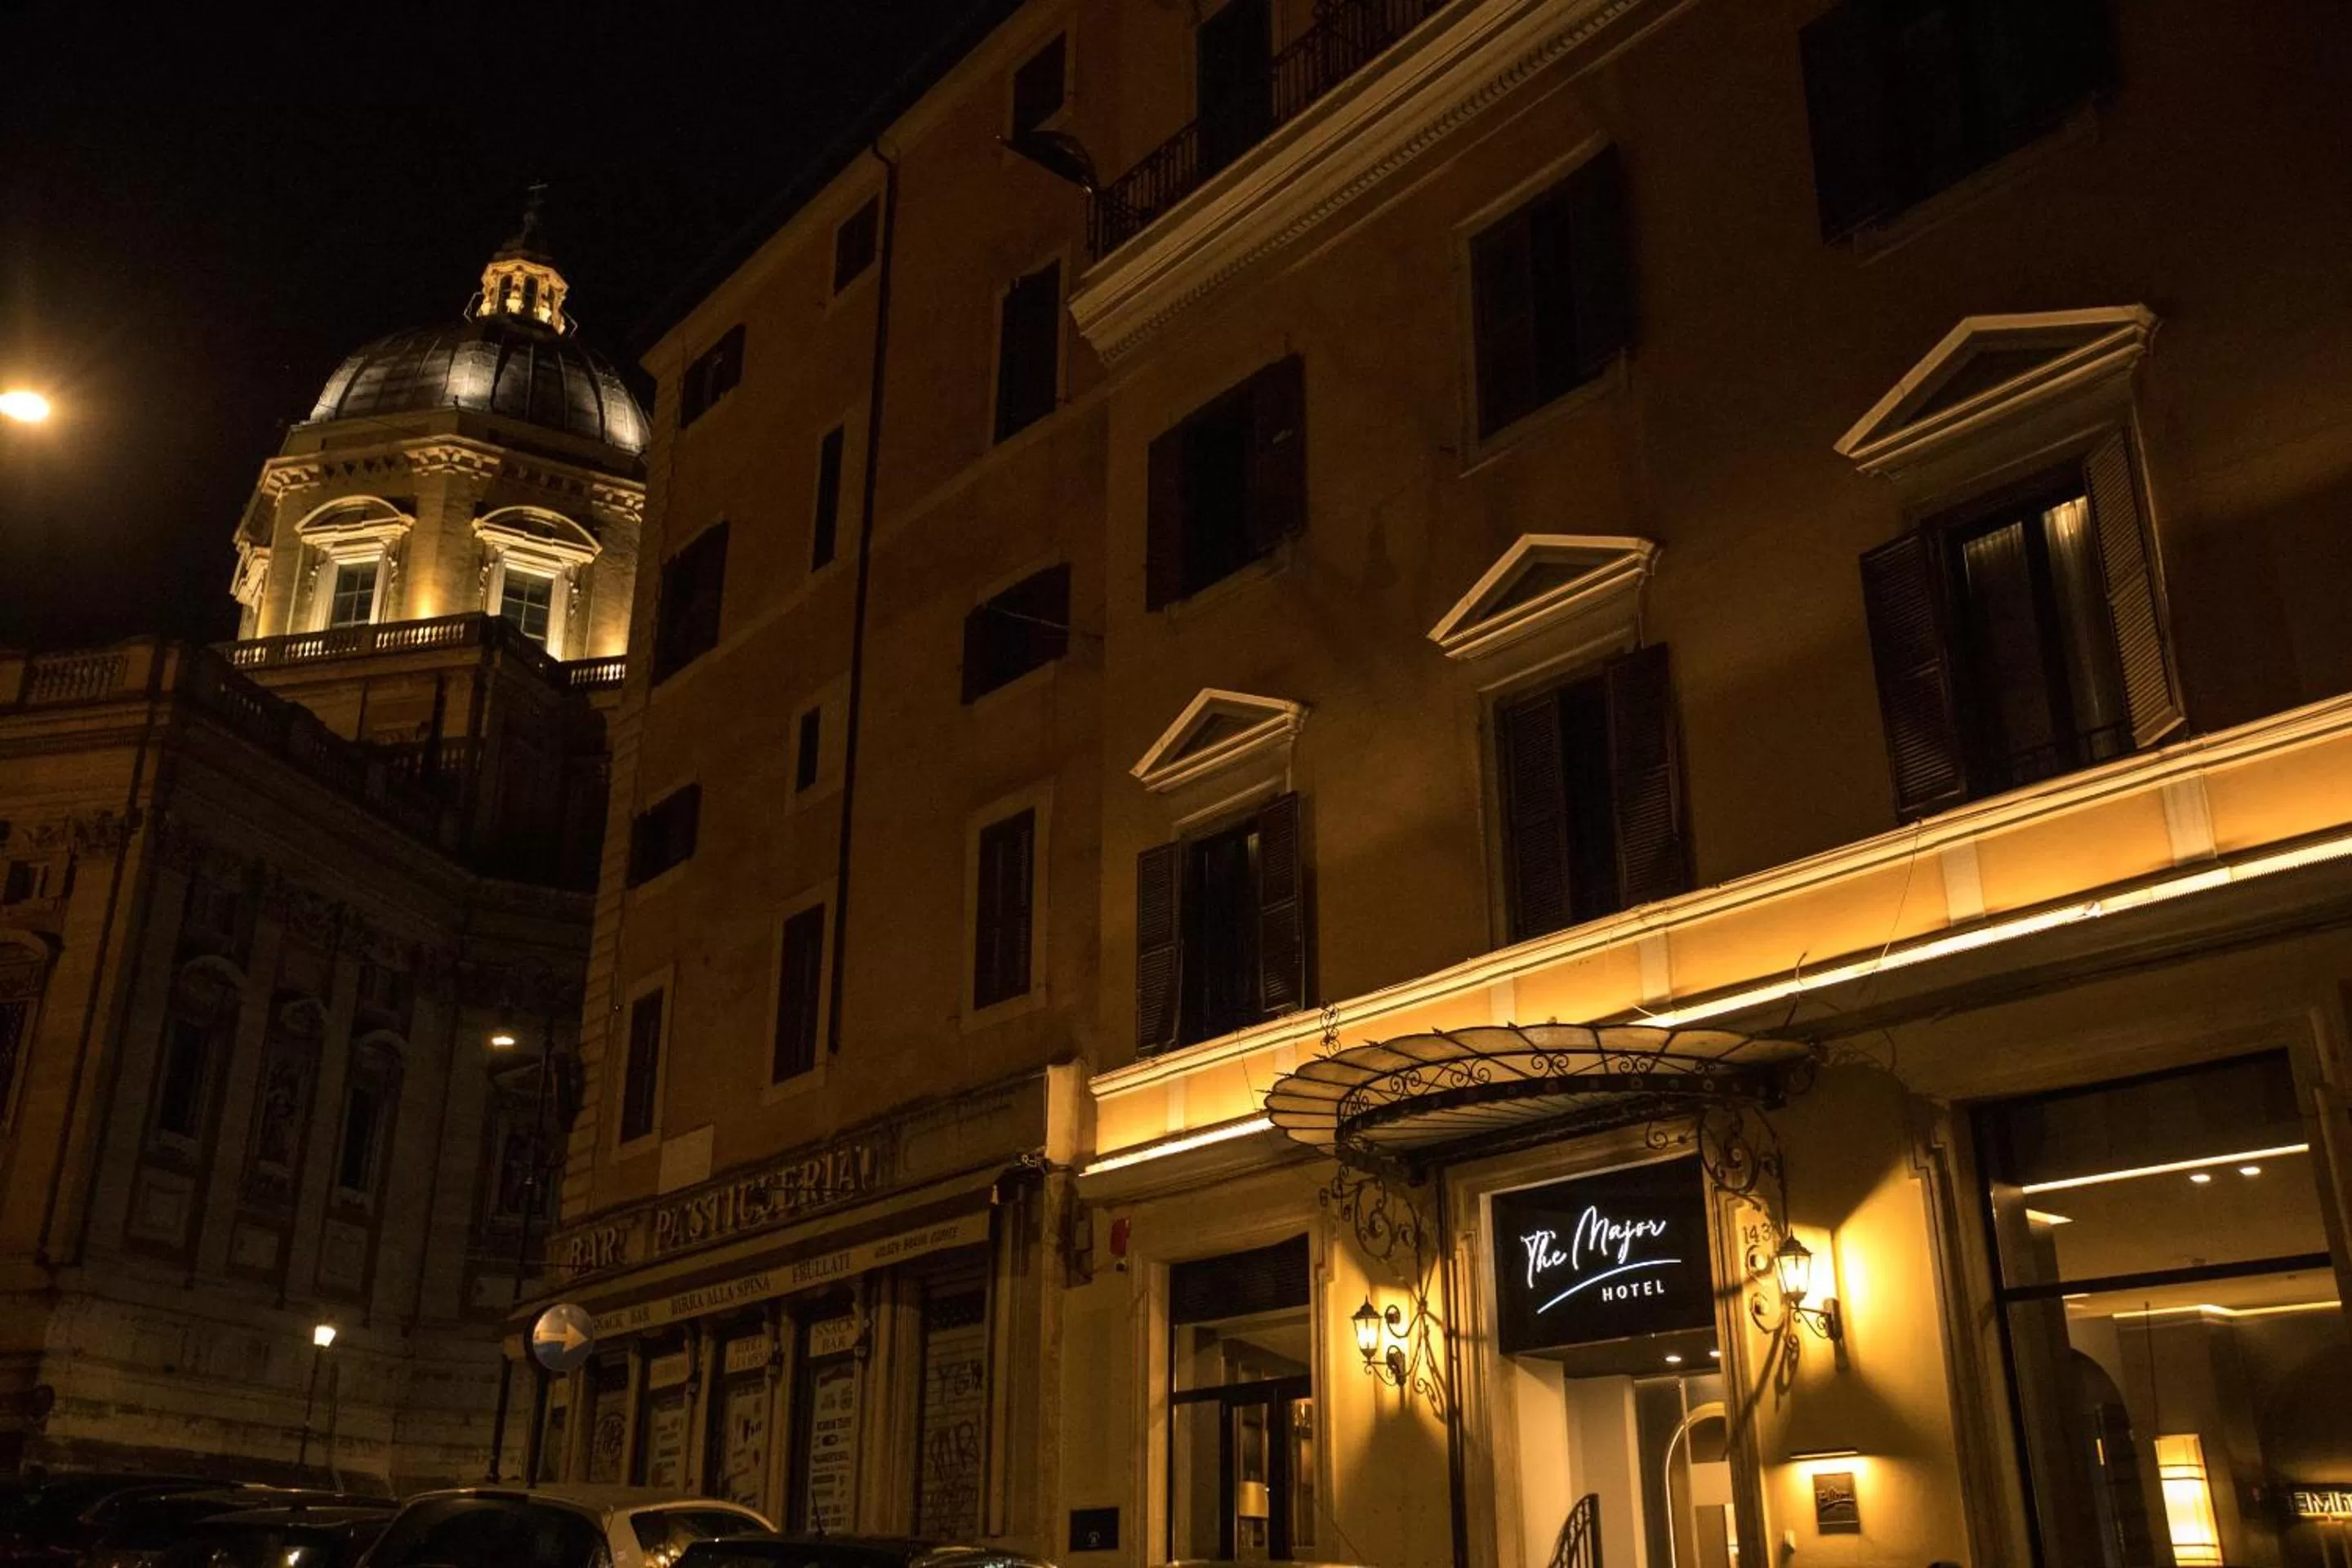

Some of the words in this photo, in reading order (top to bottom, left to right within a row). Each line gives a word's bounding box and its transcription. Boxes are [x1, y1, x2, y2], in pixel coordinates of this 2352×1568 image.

[571, 1225, 616, 1274] BAR
[1521, 1229, 1566, 1289] The
[1571, 1205, 1667, 1271] Major
[1742, 1223, 1771, 1245] 143
[736, 1272, 772, 1297] SPINA
[791, 1253, 851, 1284] FRULLATI
[1601, 1279, 1665, 1303] HOTEL
[813, 1316, 854, 1338] SNACK
